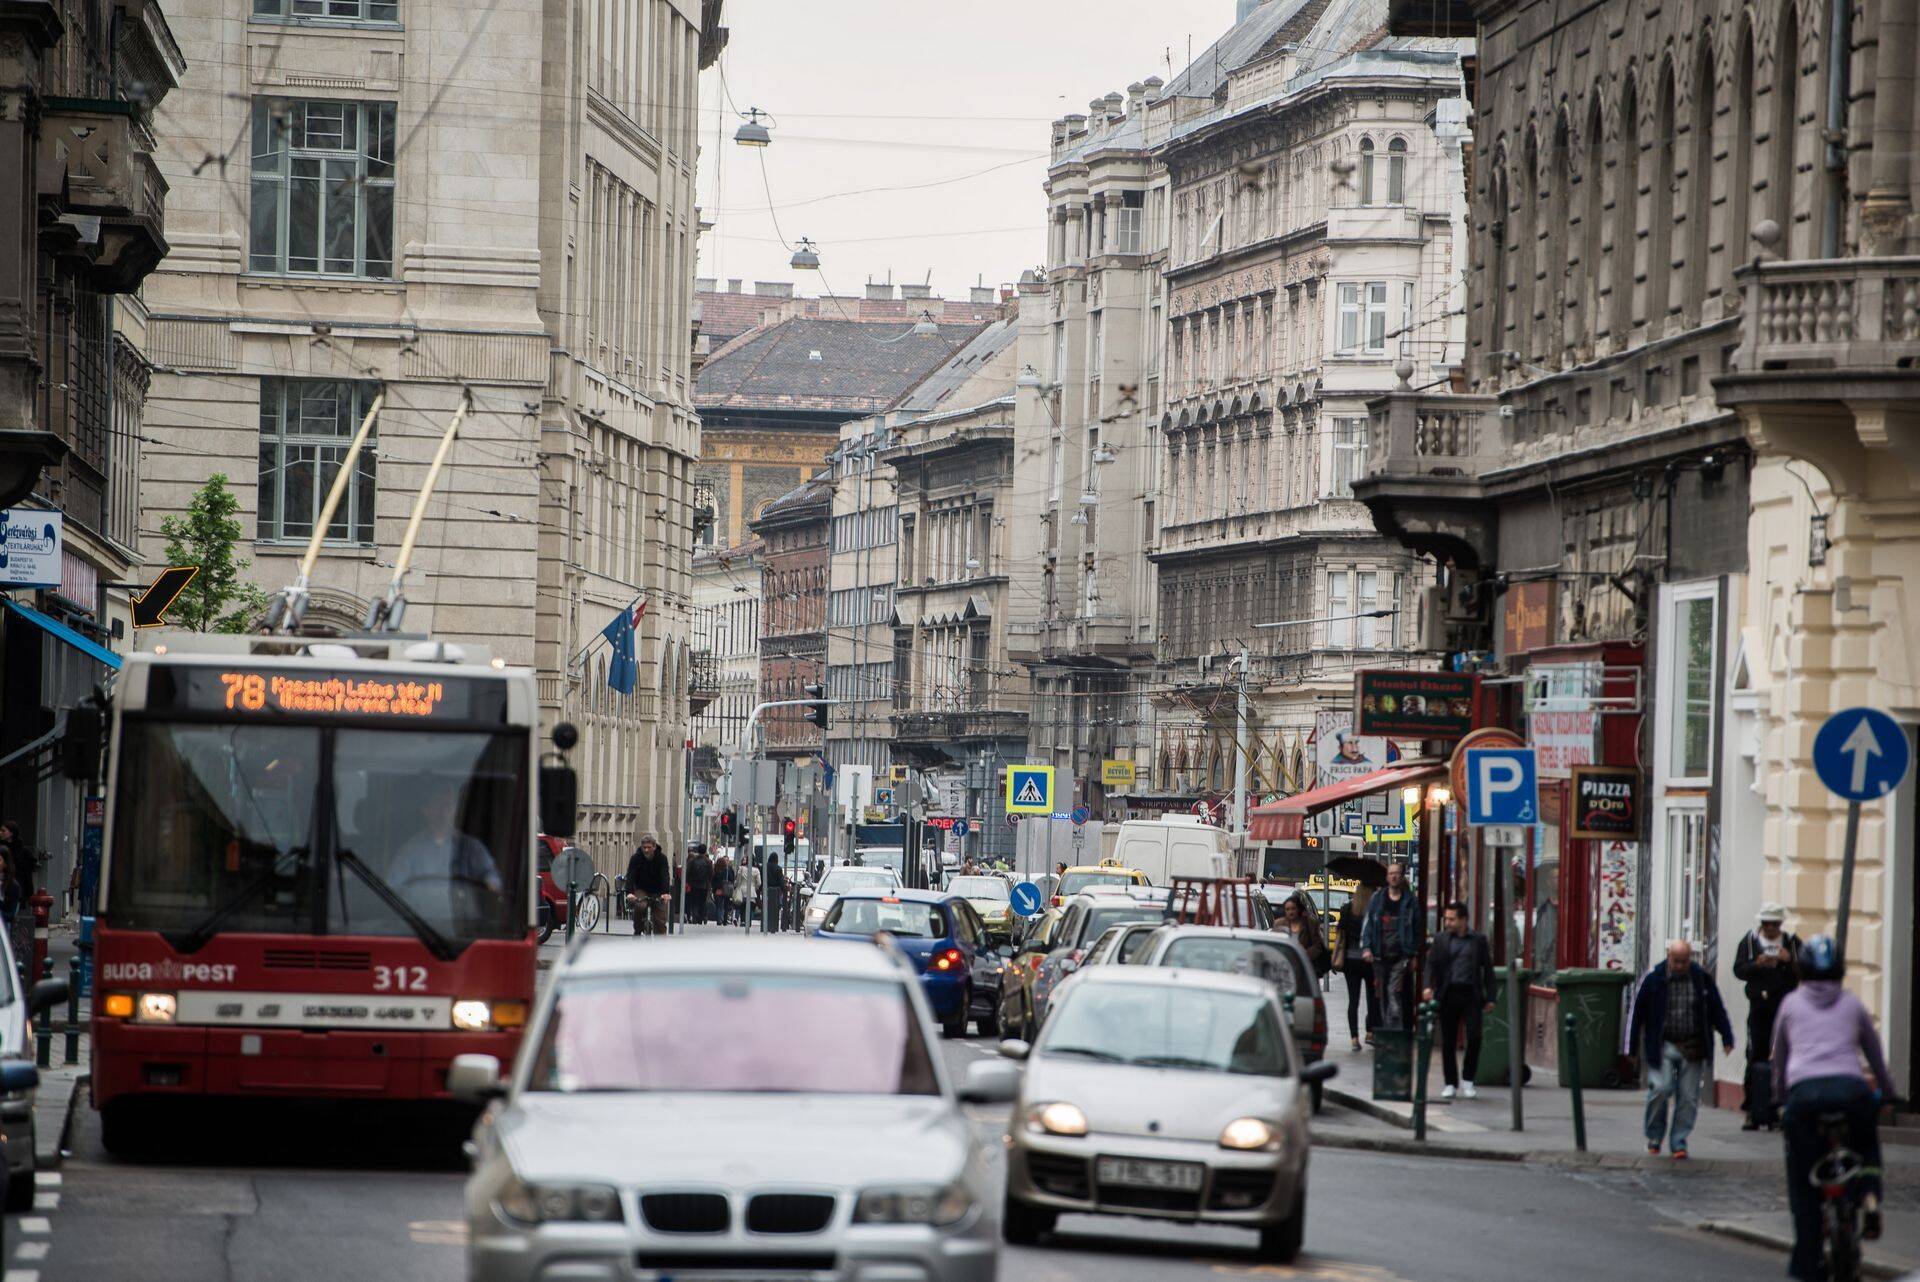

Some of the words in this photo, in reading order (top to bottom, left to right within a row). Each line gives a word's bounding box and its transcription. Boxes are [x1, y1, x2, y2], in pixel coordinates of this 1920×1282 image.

[222, 673, 265, 710] 78
[1318, 713, 1353, 734] RESTA
[1480, 756, 1524, 817] P
[1582, 780, 1631, 797] PIAZZA
[1306, 837, 1318, 848] 70
[372, 966, 428, 991] 312
